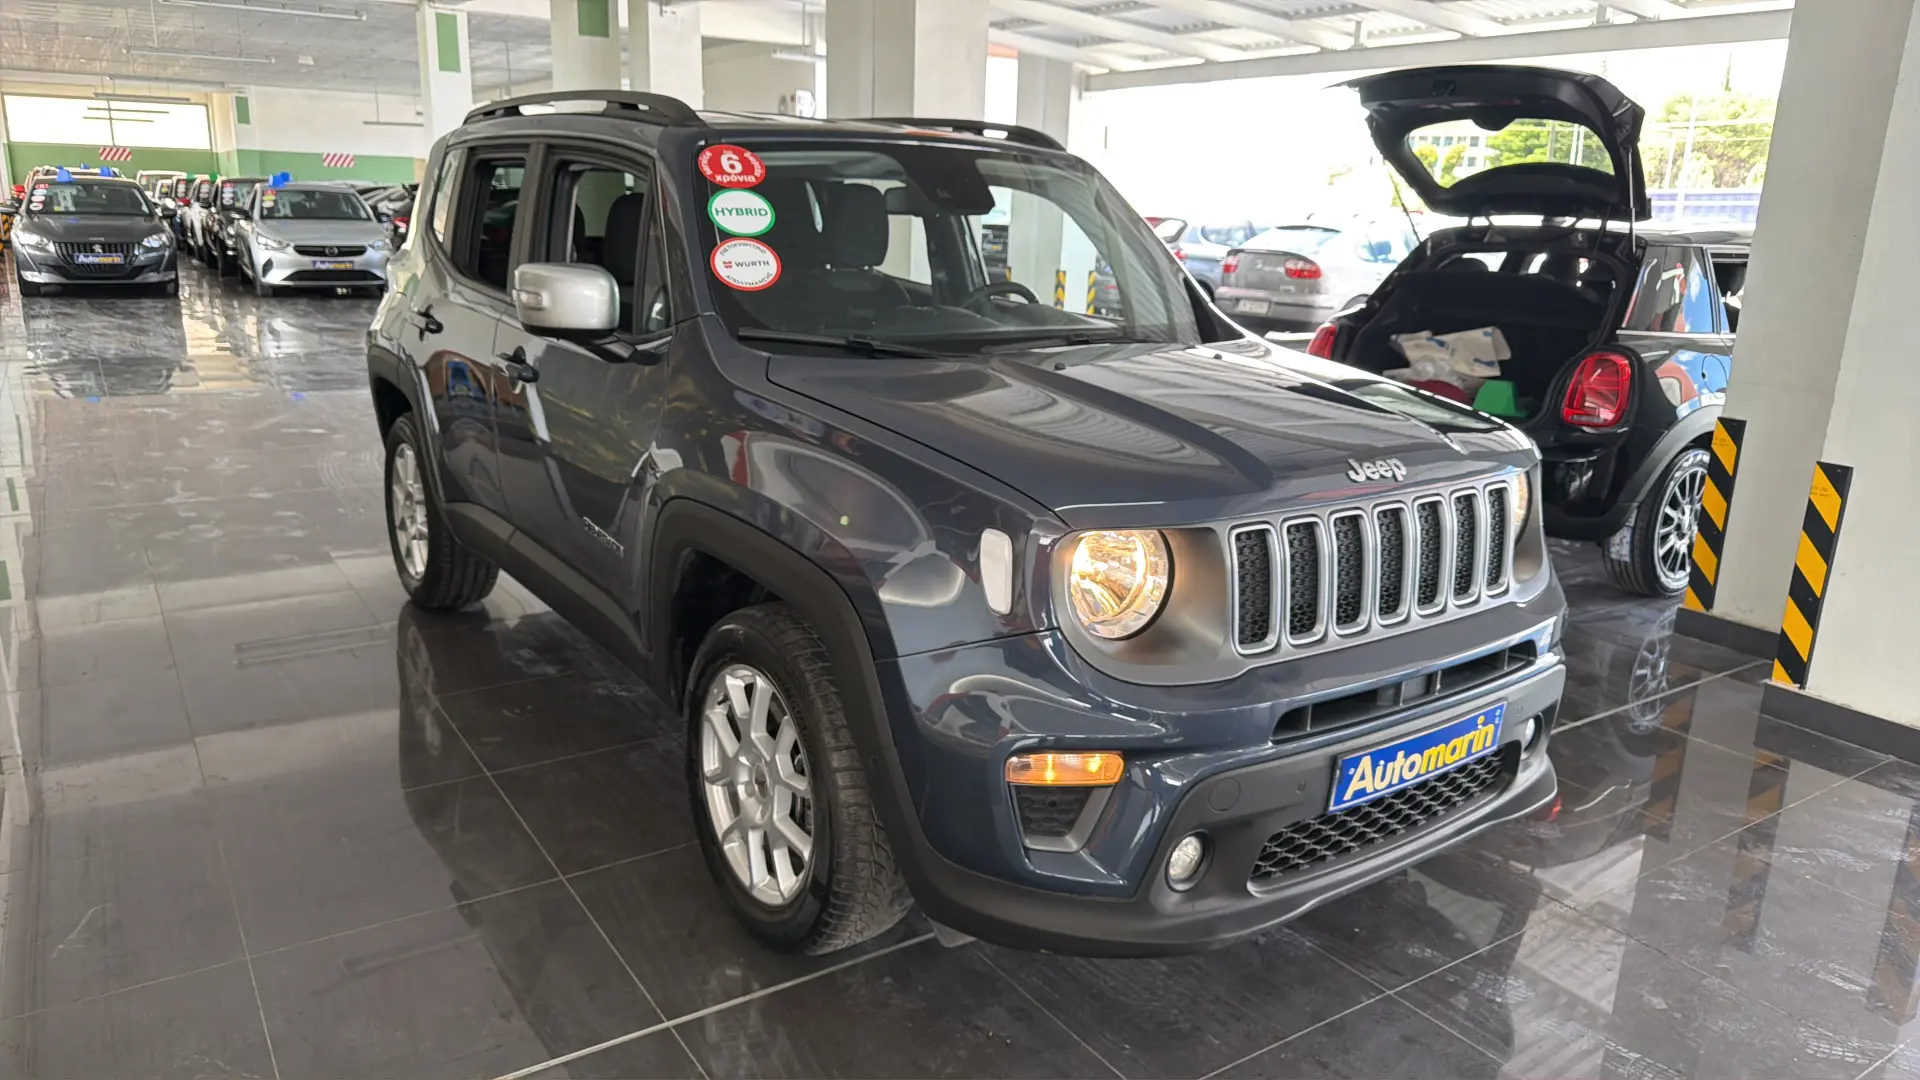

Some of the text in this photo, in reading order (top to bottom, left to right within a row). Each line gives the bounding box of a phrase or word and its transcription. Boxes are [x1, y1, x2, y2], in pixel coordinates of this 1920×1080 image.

[720, 152, 743, 174] 6
[714, 173, 757, 183] χρόνια
[714, 206, 769, 217] HYBRID
[1347, 458, 1407, 483] Jeep
[1342, 715, 1495, 801] Automarin
